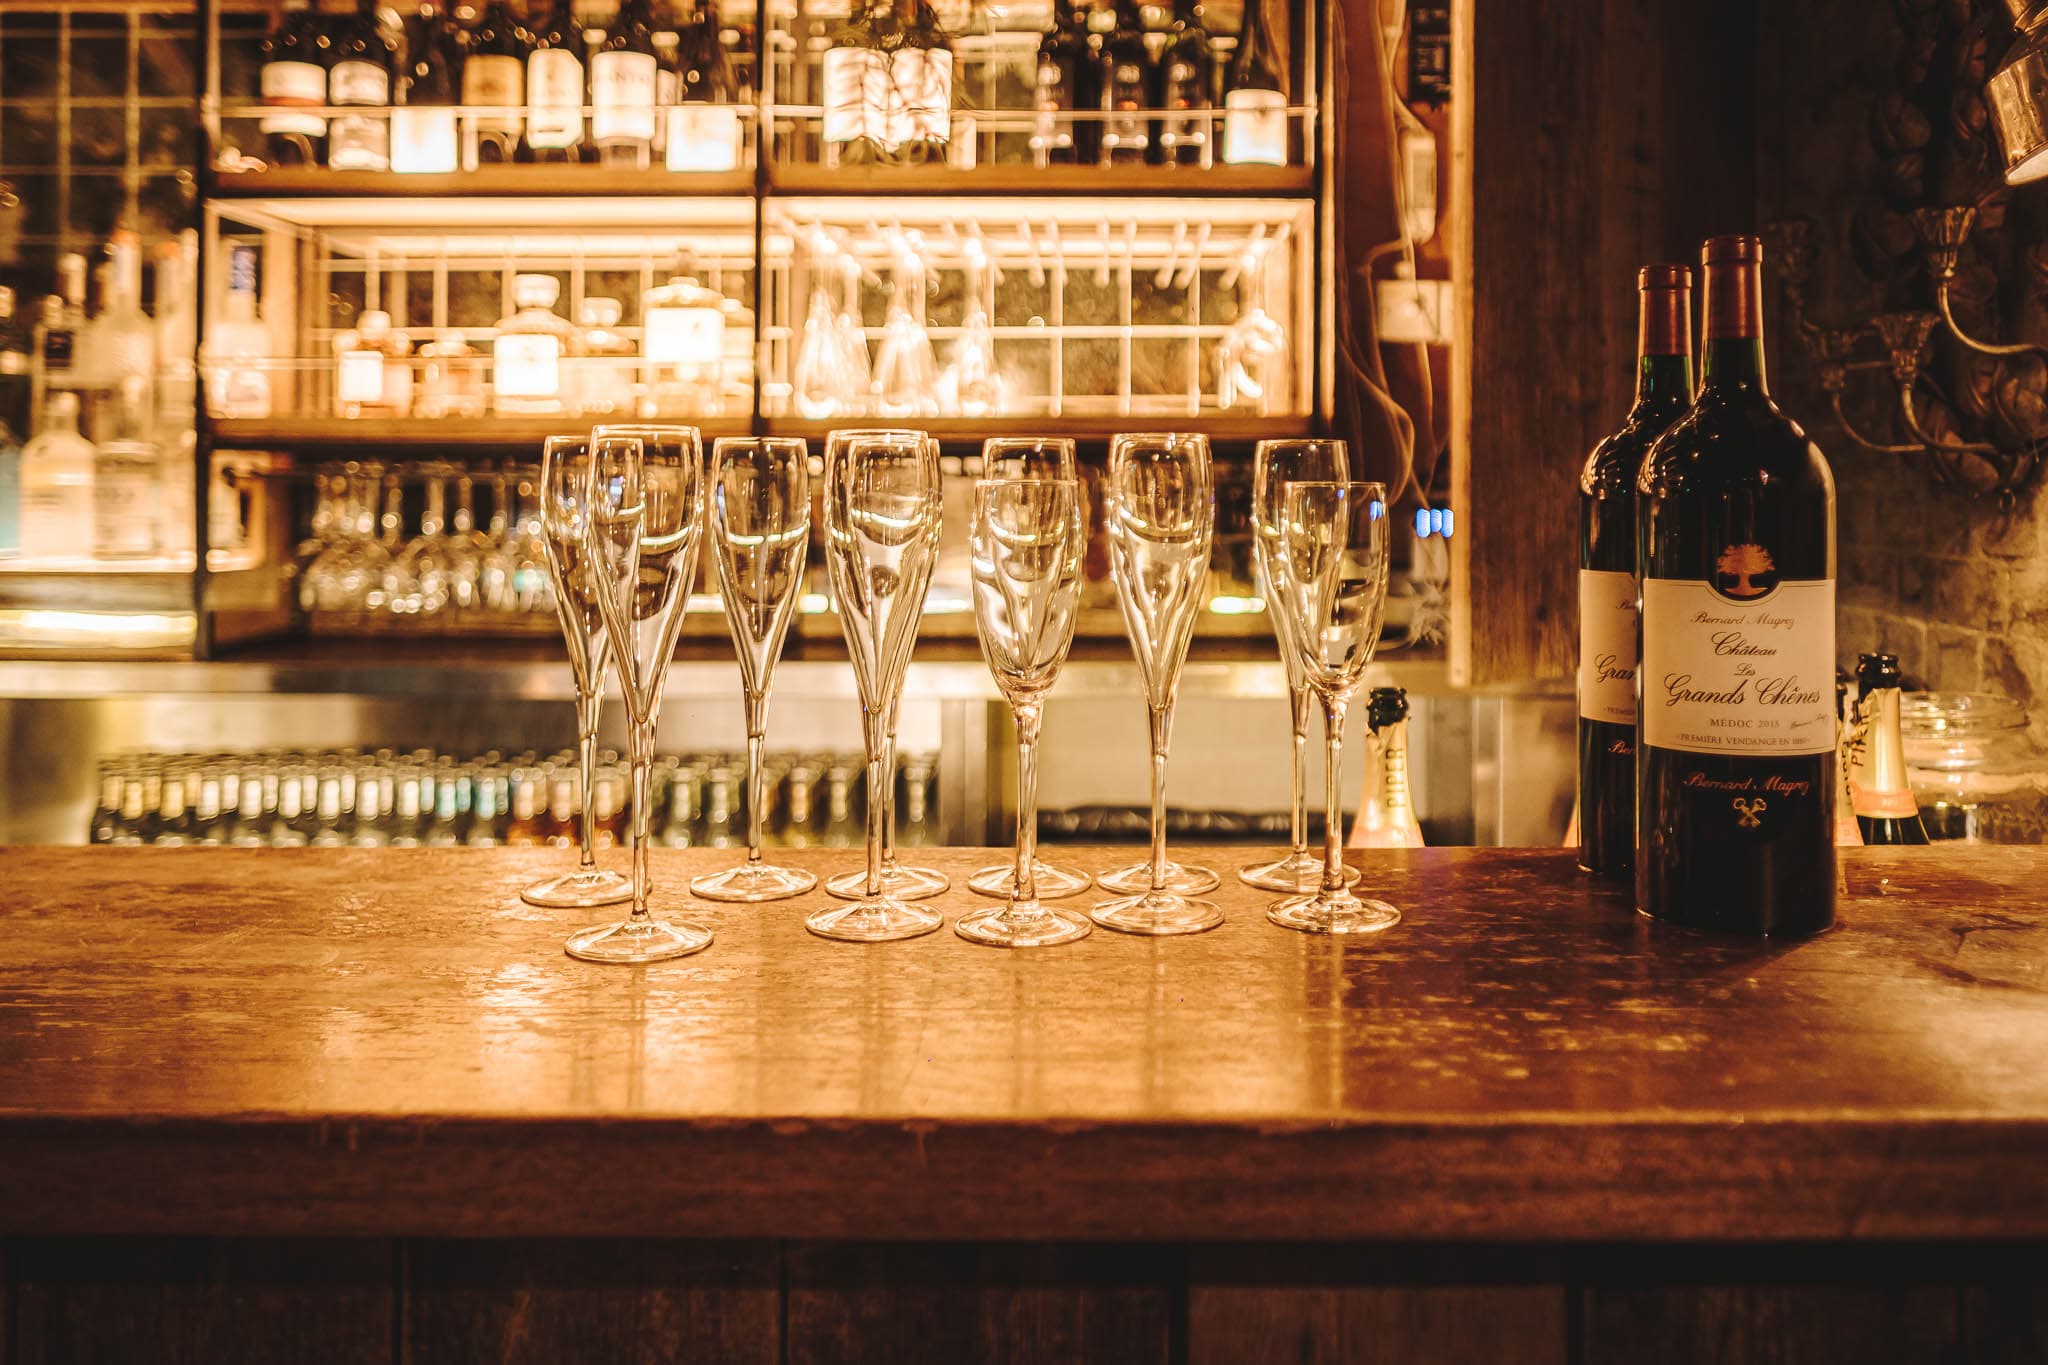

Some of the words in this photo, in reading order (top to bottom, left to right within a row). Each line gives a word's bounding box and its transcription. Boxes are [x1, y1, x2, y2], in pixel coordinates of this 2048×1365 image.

[1691, 610, 1745, 624] Bernard
[1747, 612, 1794, 630] Magrez
[1711, 631, 1777, 656] Château
[1594, 653, 1635, 683] Gran
[1734, 662, 1756, 676] Les
[1664, 673, 1749, 707] Grands
[1755, 675, 1820, 705] Chênes
[1710, 717, 1753, 729] MÉDOC
[1758, 719, 1780, 728] 2015
[1726, 737, 1775, 746] VENDANGE
[1385, 748, 1406, 808] PIPER
[1682, 771, 1753, 790] Bernard
[1755, 775, 1809, 796] Magrez
